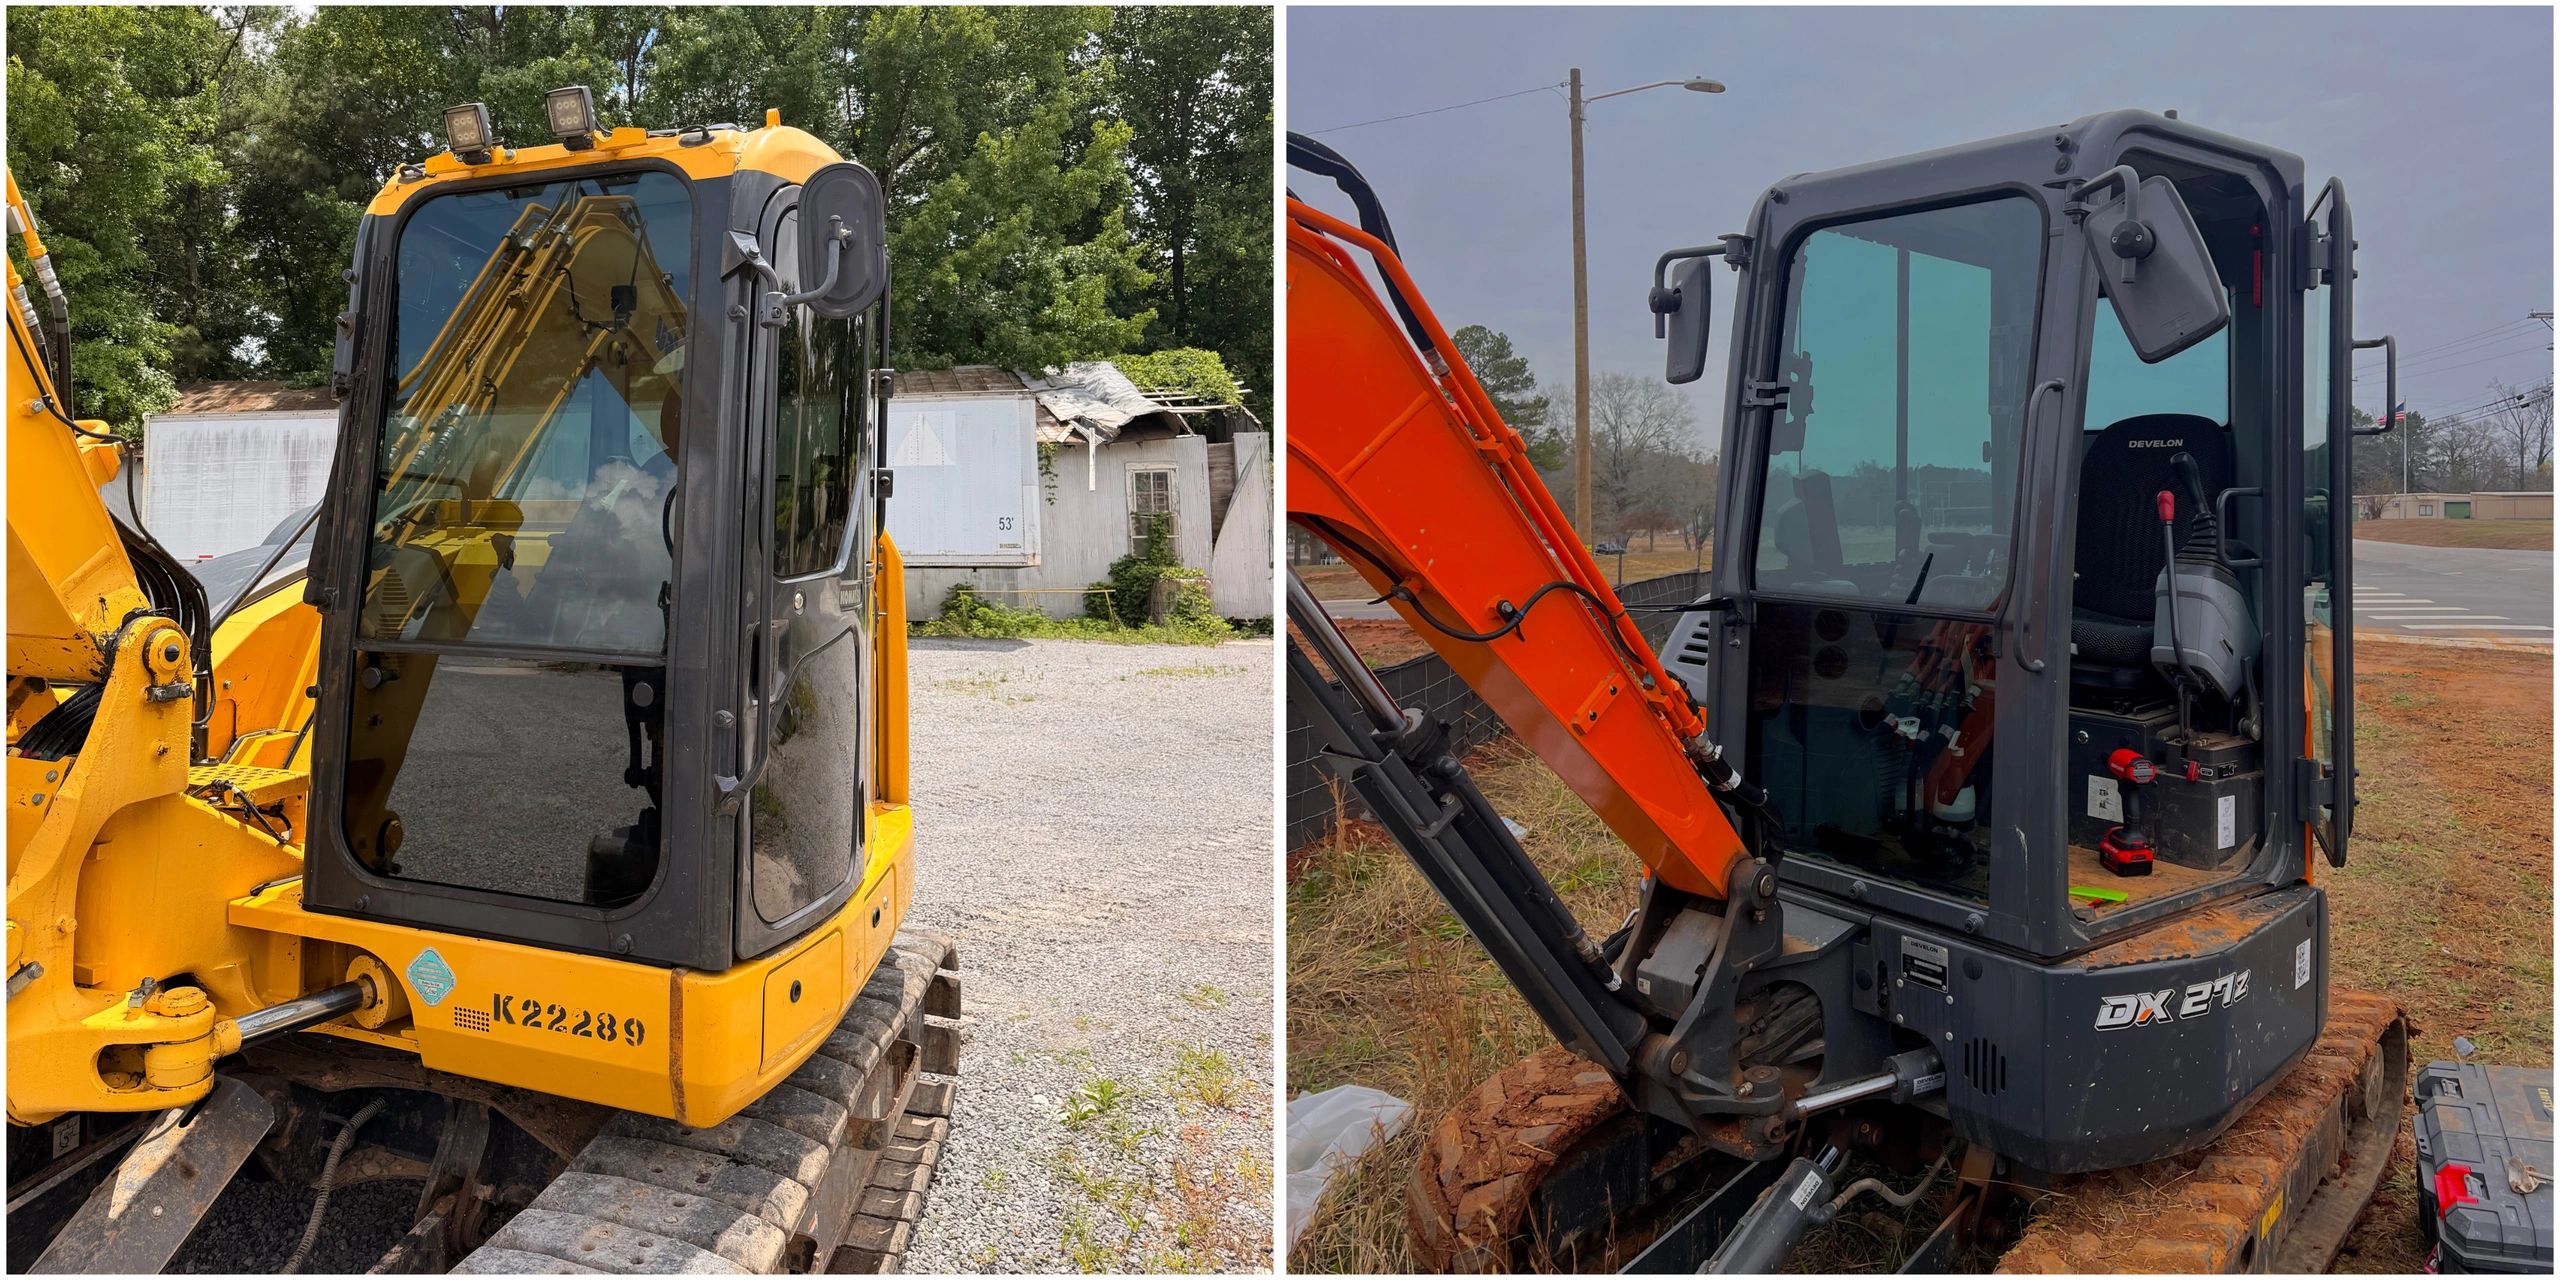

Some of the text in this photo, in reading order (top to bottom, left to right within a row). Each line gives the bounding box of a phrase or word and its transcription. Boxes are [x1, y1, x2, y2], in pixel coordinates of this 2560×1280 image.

[2128, 439, 2184, 448] DEVELON
[999, 517, 1014, 530] 53'
[493, 993, 645, 1046] K22289
[2095, 989, 2176, 1031] DX
[1800, 1181, 1820, 1206] DEVELON
